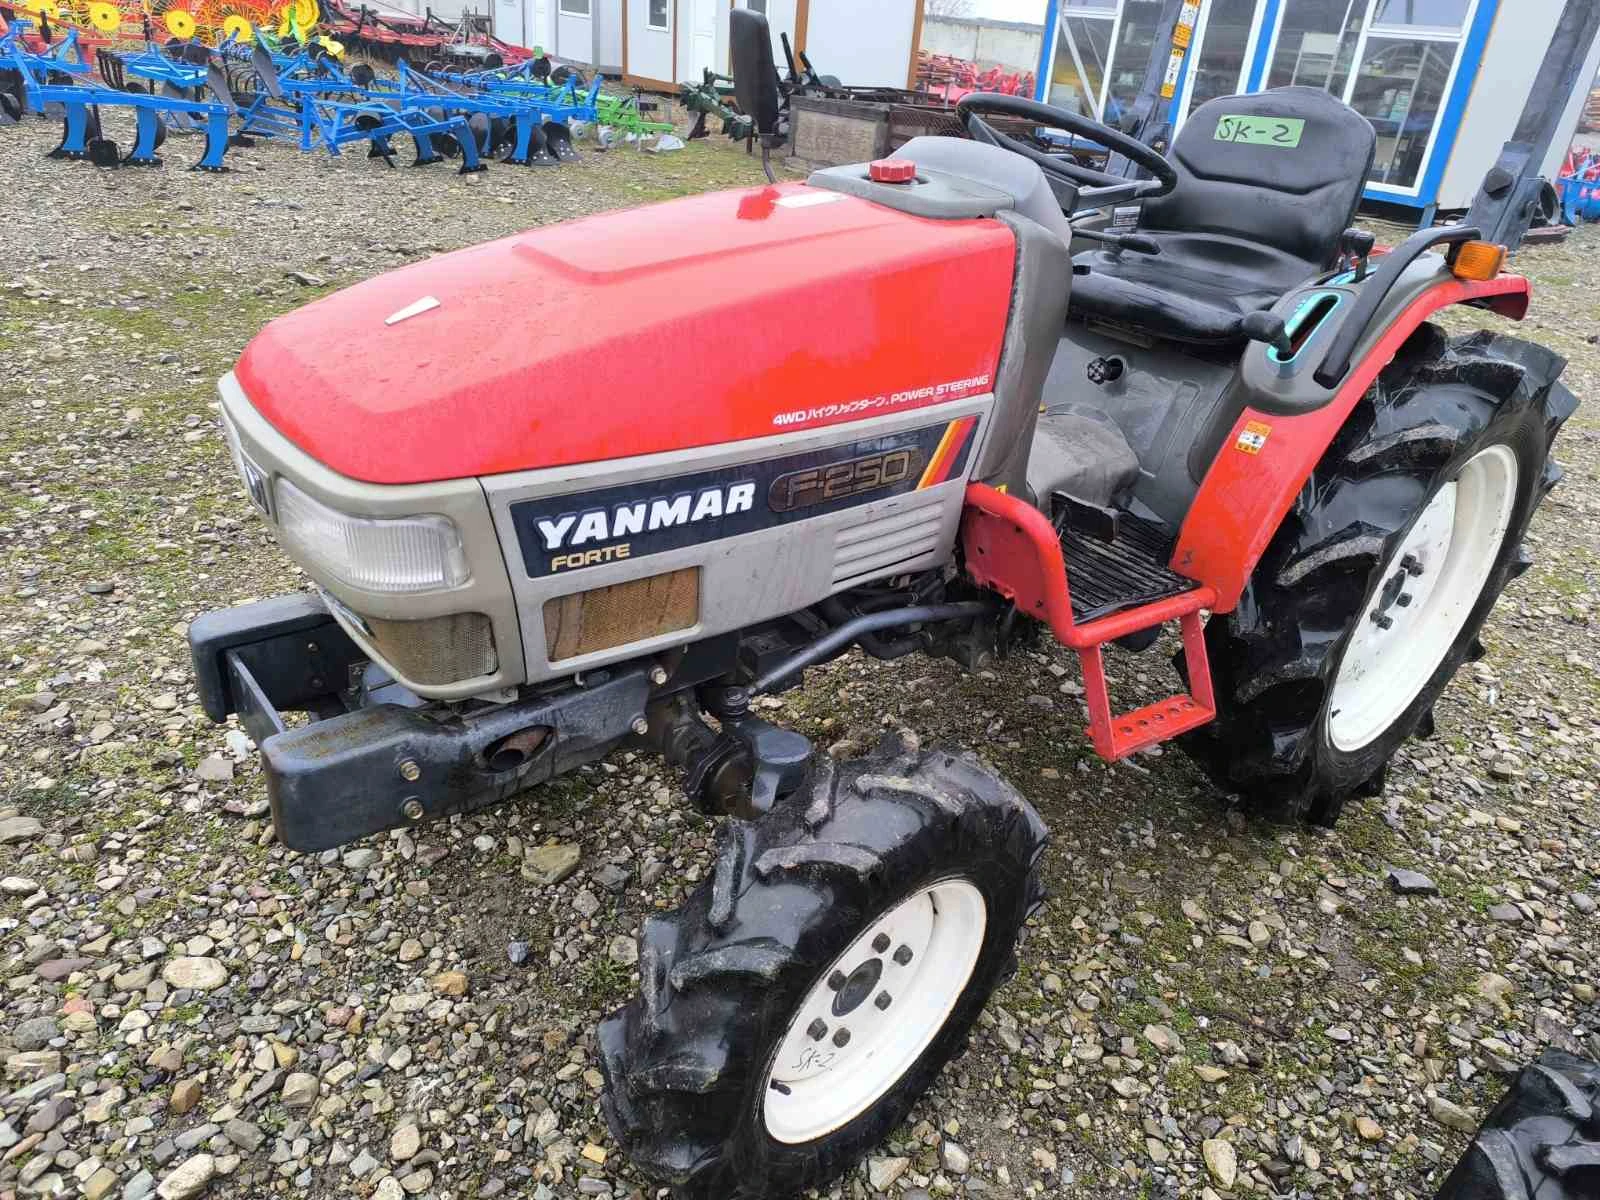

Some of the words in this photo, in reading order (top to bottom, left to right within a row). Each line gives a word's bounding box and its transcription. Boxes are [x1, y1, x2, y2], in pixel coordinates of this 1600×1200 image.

[773, 409, 806, 426] 4WD
[890, 386, 934, 405] POWER
[934, 374, 989, 396] STEERING
[536, 482, 756, 550] YANMAR
[551, 543, 630, 572] FORTE
